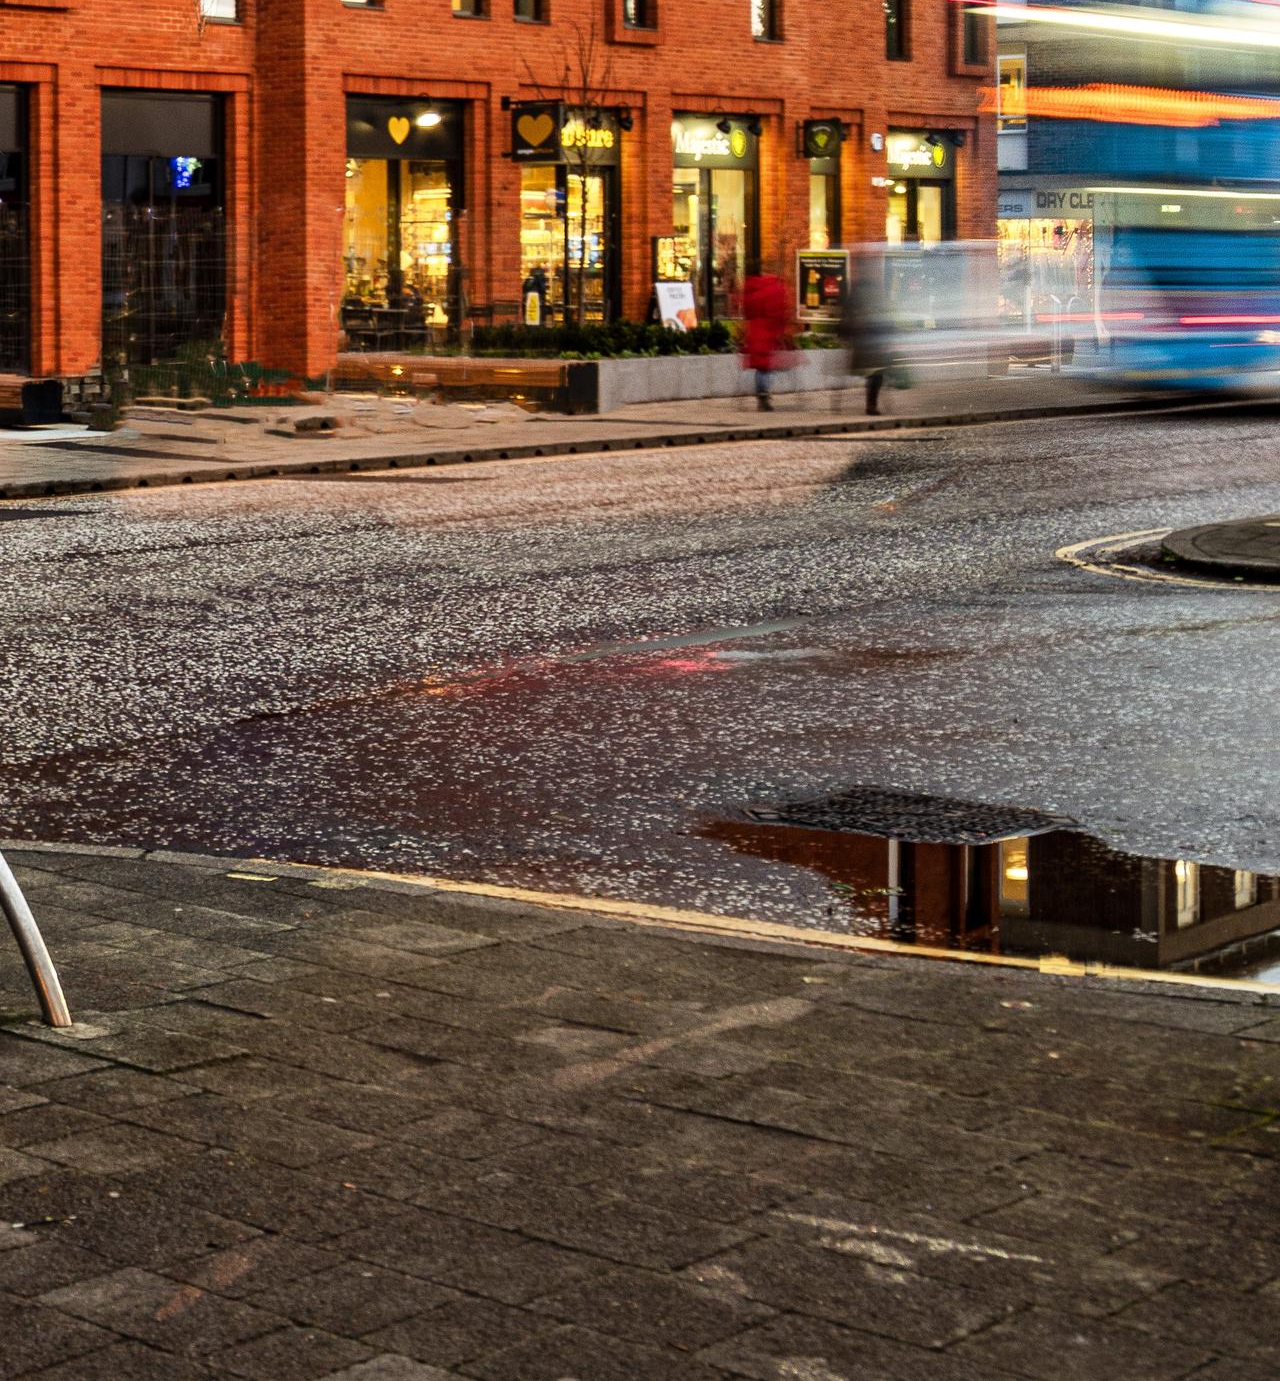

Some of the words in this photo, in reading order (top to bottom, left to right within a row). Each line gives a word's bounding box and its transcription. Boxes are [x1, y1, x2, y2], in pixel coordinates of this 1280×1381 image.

[674, 131, 730, 161] Majestic
[886, 138, 932, 171] Majestic
[1037, 192, 1066, 208] DRY
[1070, 193, 1094, 209] CLE
